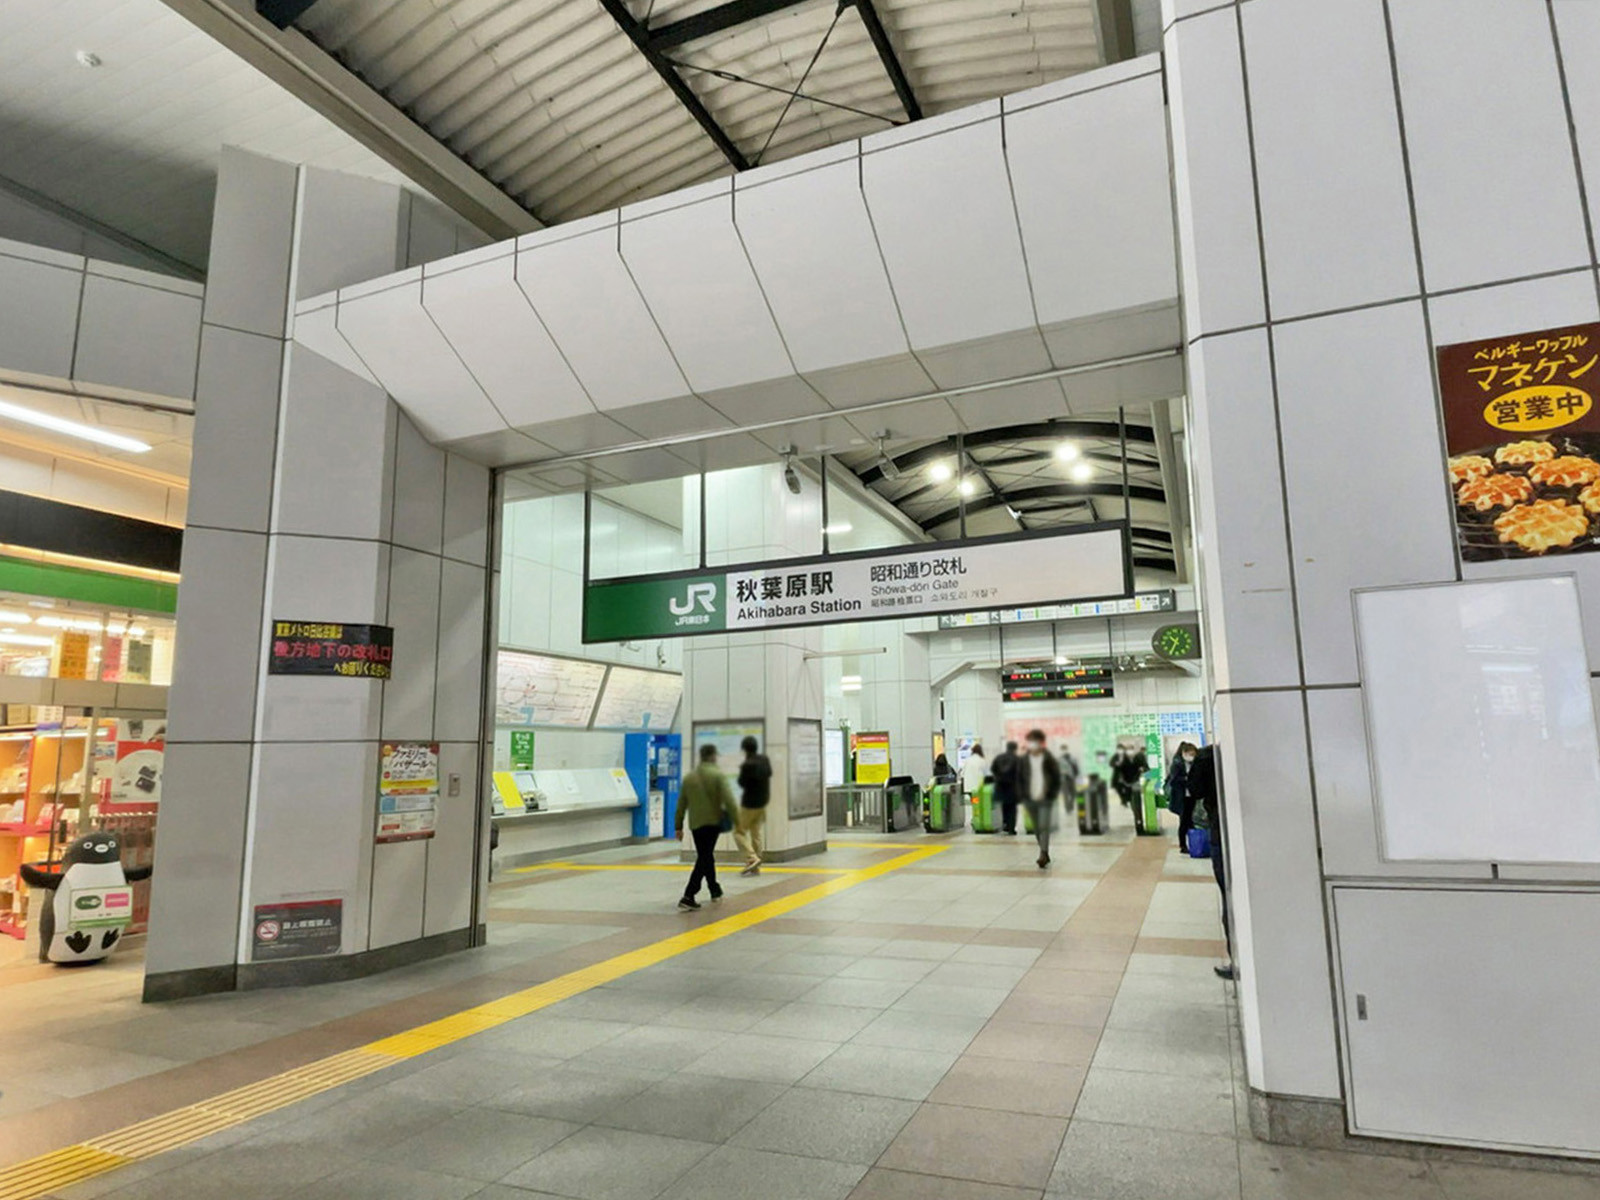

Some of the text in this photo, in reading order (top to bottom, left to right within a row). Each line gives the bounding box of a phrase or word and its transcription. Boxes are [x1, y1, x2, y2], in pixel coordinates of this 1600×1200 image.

[1474, 334, 1588, 361] ベルギーワッフル
[1467, 353, 1599, 392] マネケン
[1492, 391, 1584, 424] 営業中
[870, 556, 967, 583] 昭和通り改札
[669, 582, 717, 616] JR
[736, 571, 833, 603] 秋葉原駅
[932, 579, 959, 591] Gate
[737, 598, 862, 621] Akihabara Station
